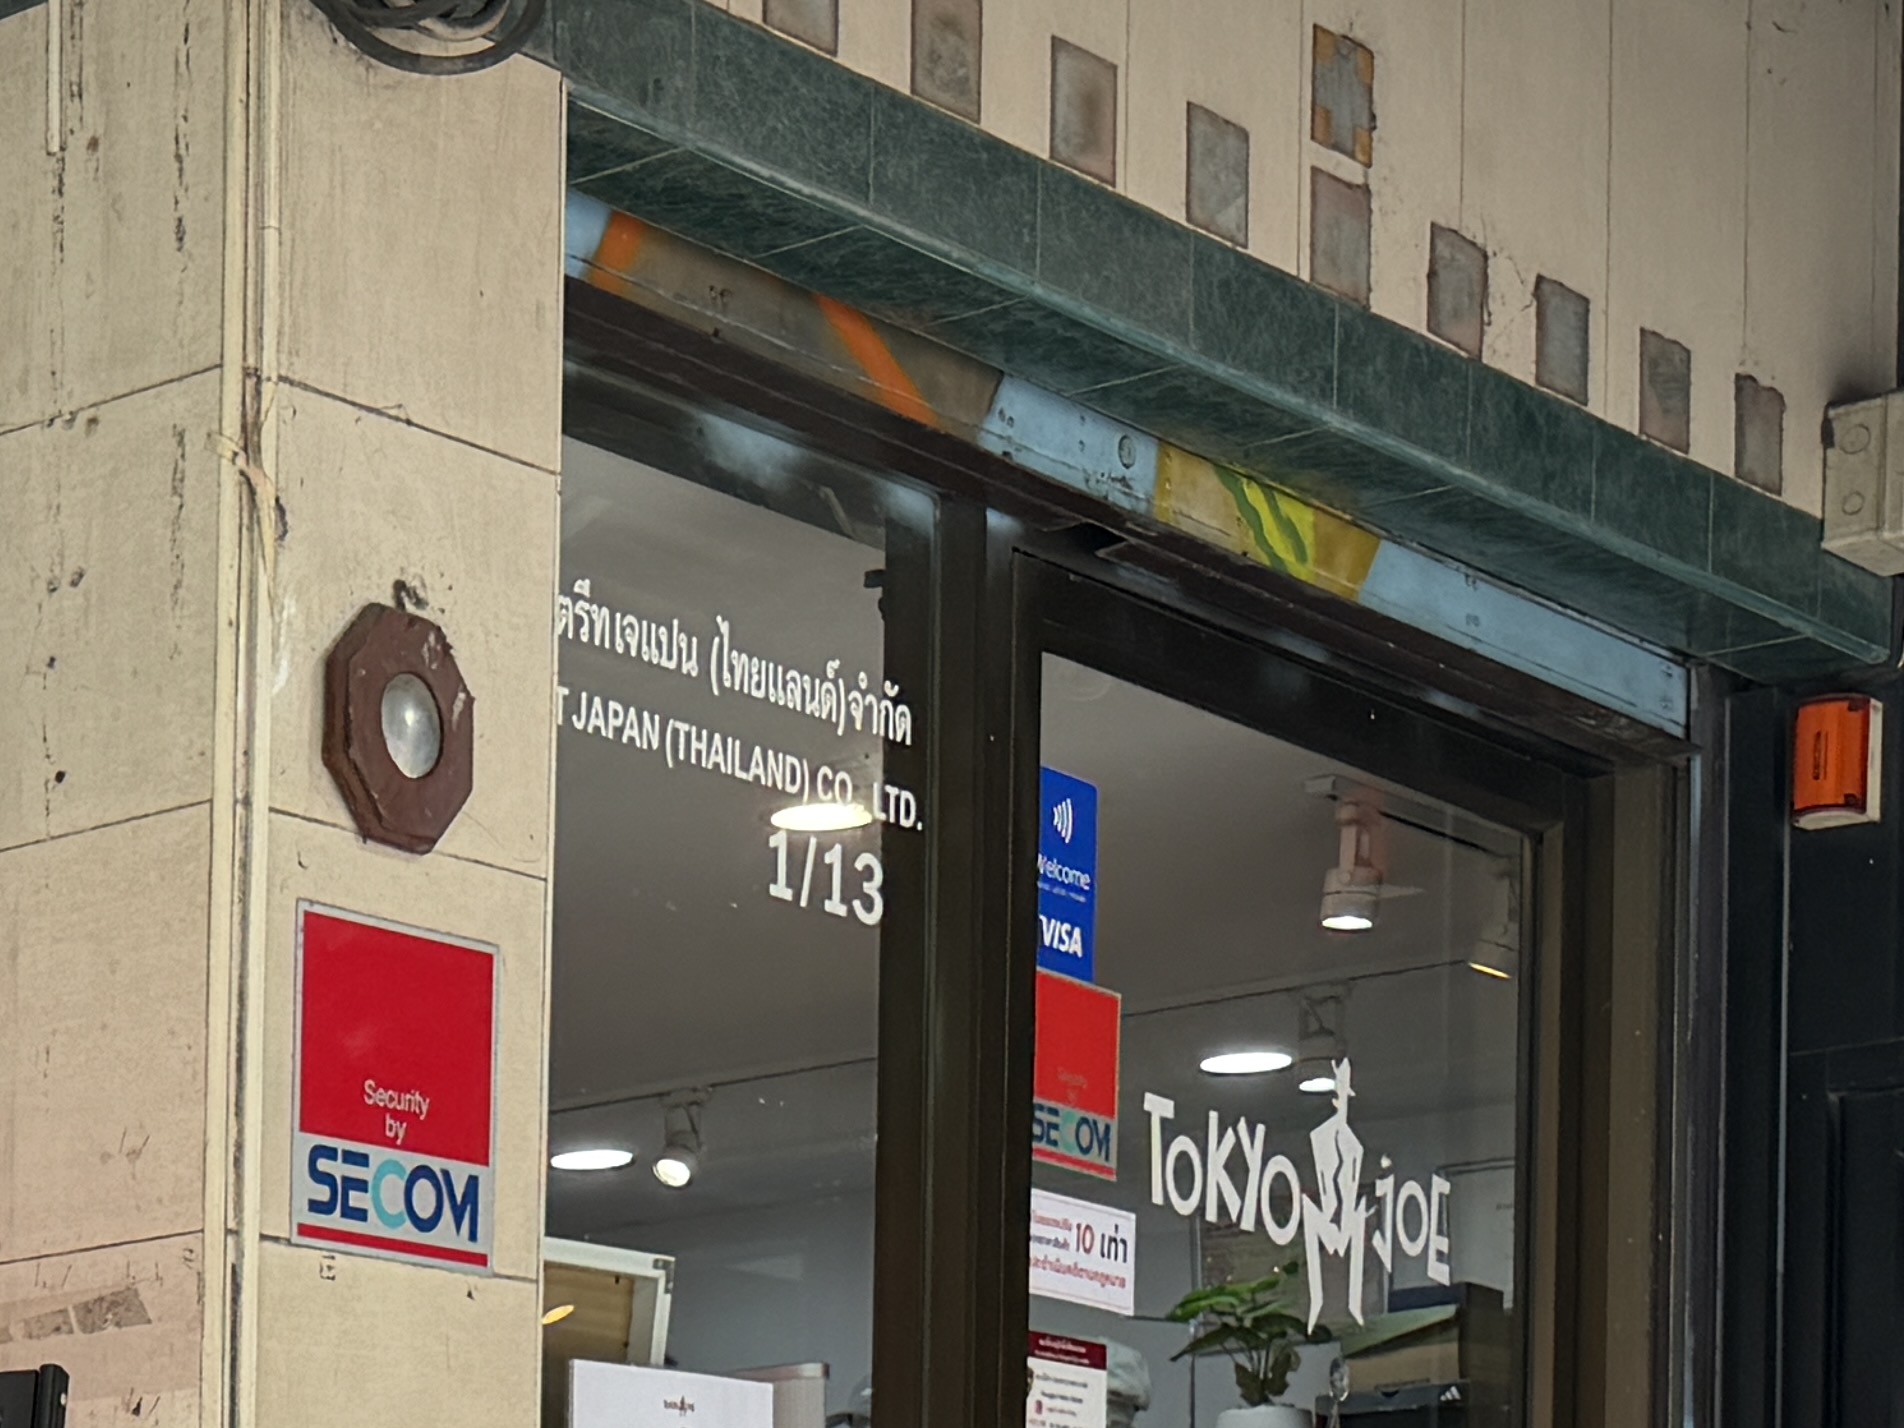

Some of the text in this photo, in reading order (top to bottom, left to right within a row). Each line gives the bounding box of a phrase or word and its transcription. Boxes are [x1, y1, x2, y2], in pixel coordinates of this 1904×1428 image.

[572, 692, 660, 751] JAPAN
[665, 718, 810, 803] (THAILAND)
[872, 781, 923, 831] LTD.
[768, 831, 884, 926] 1/13
[1039, 914, 1084, 959] VISA
[363, 1077, 431, 1121] Security
[383, 1114, 408, 1147] by
[1032, 1102, 1112, 1163] SECOM
[307, 1142, 480, 1244] SECOM
[1143, 1092, 1452, 1288] TOKYO JOE
[1075, 1222, 1095, 1255] 10
